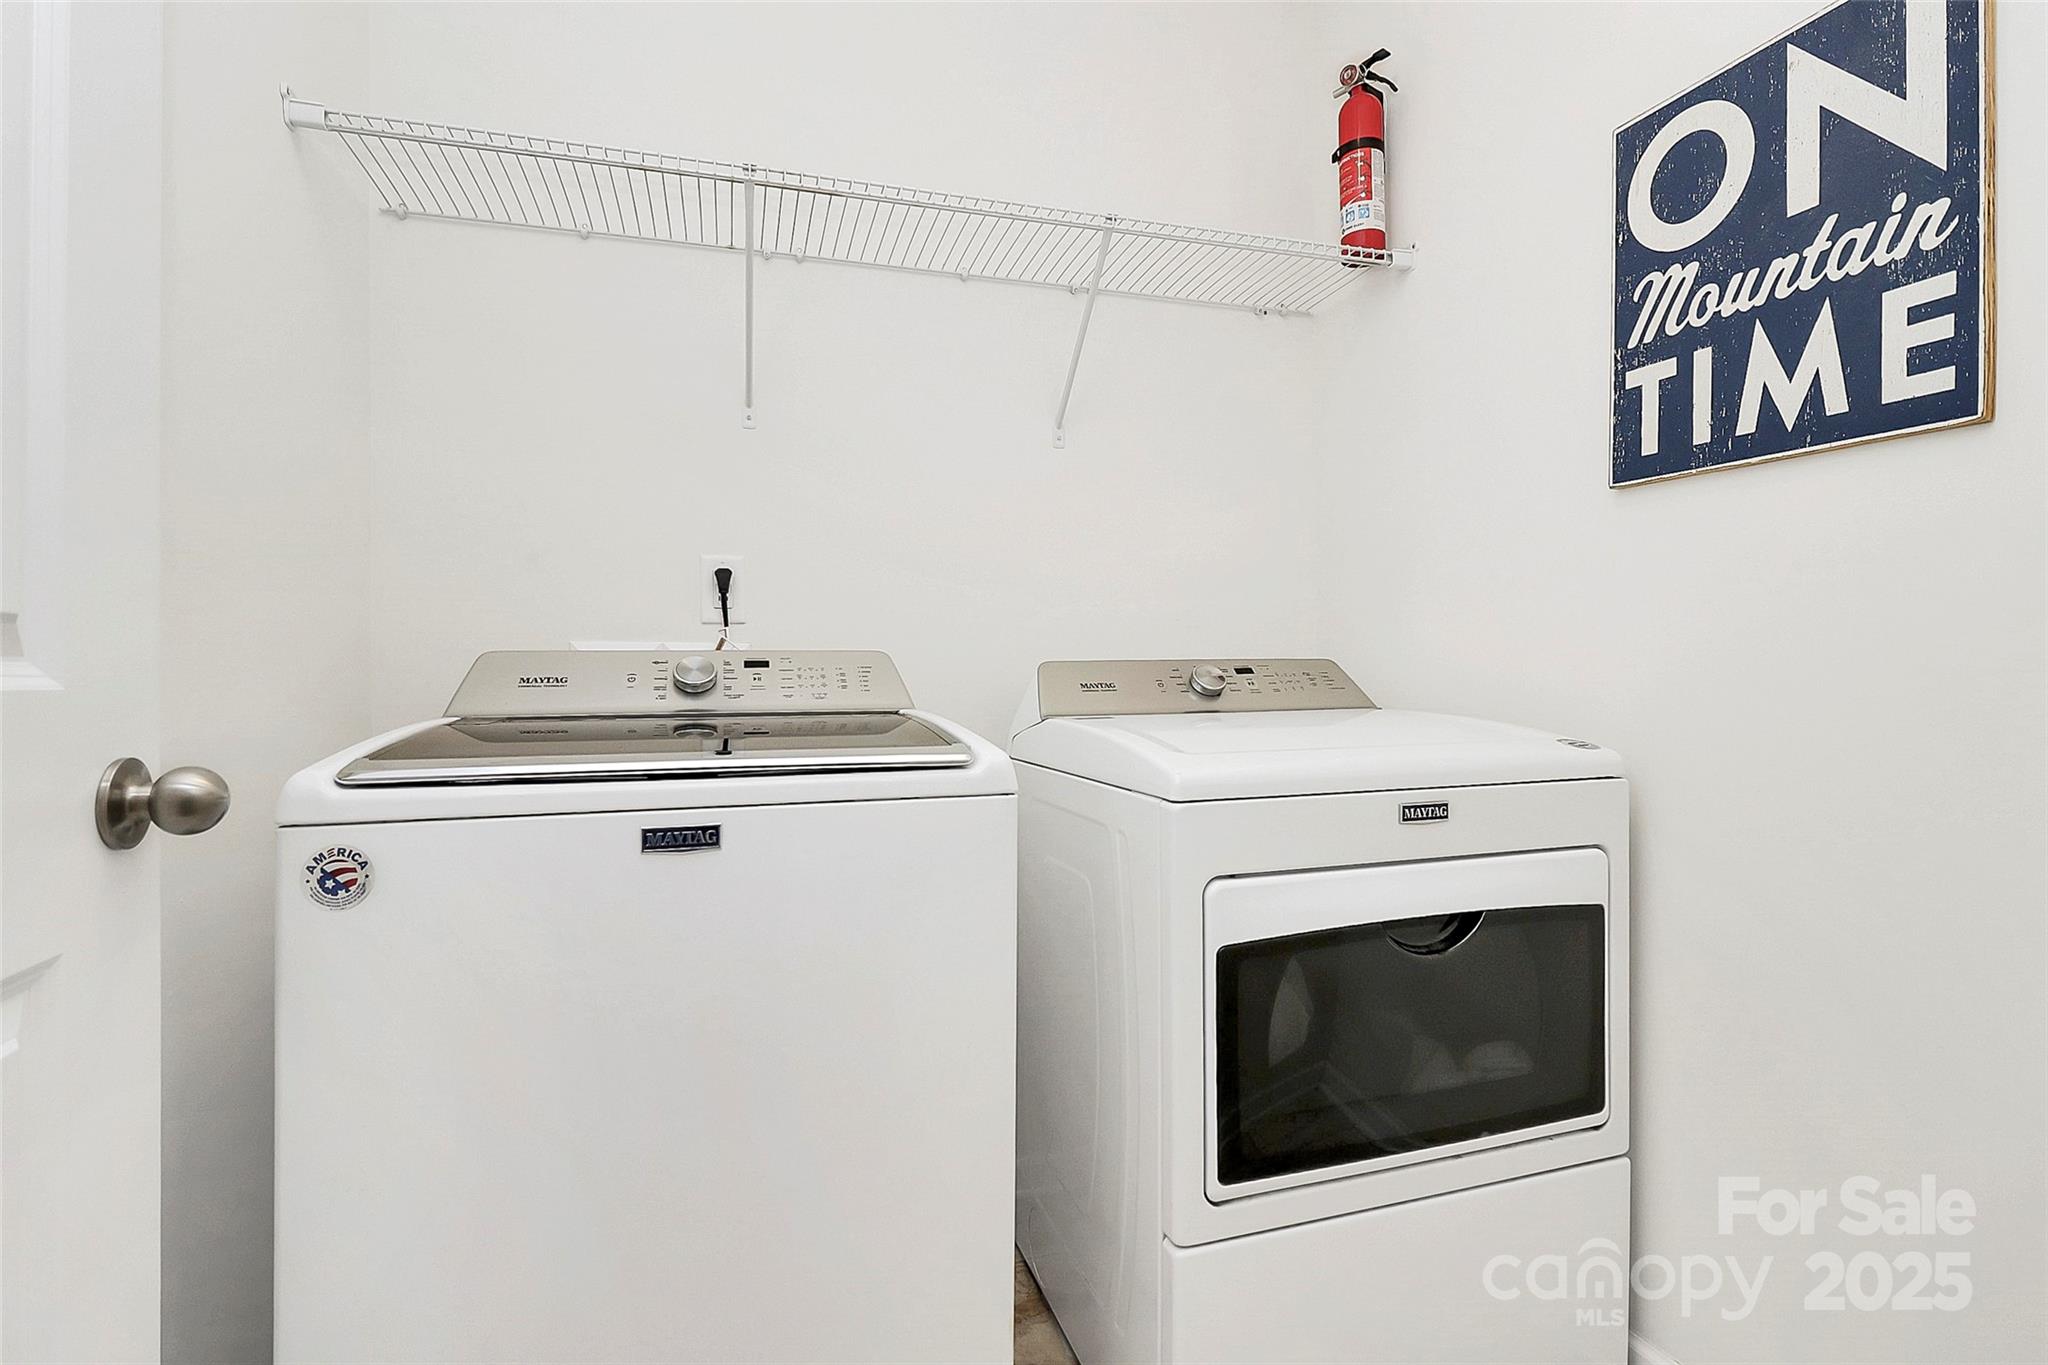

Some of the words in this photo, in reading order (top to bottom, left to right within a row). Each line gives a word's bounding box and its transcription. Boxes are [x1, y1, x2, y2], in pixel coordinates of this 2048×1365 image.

[1627, 0, 1947, 252] ON
[1627, 192, 1958, 349] Mountain
[1625, 271, 1957, 457] TIME
[518, 676, 568, 684] MAYTAG
[1403, 805, 1447, 819] MAYTAG
[645, 829, 717, 847] MAYTAG
[305, 847, 369, 875] AMERICA
